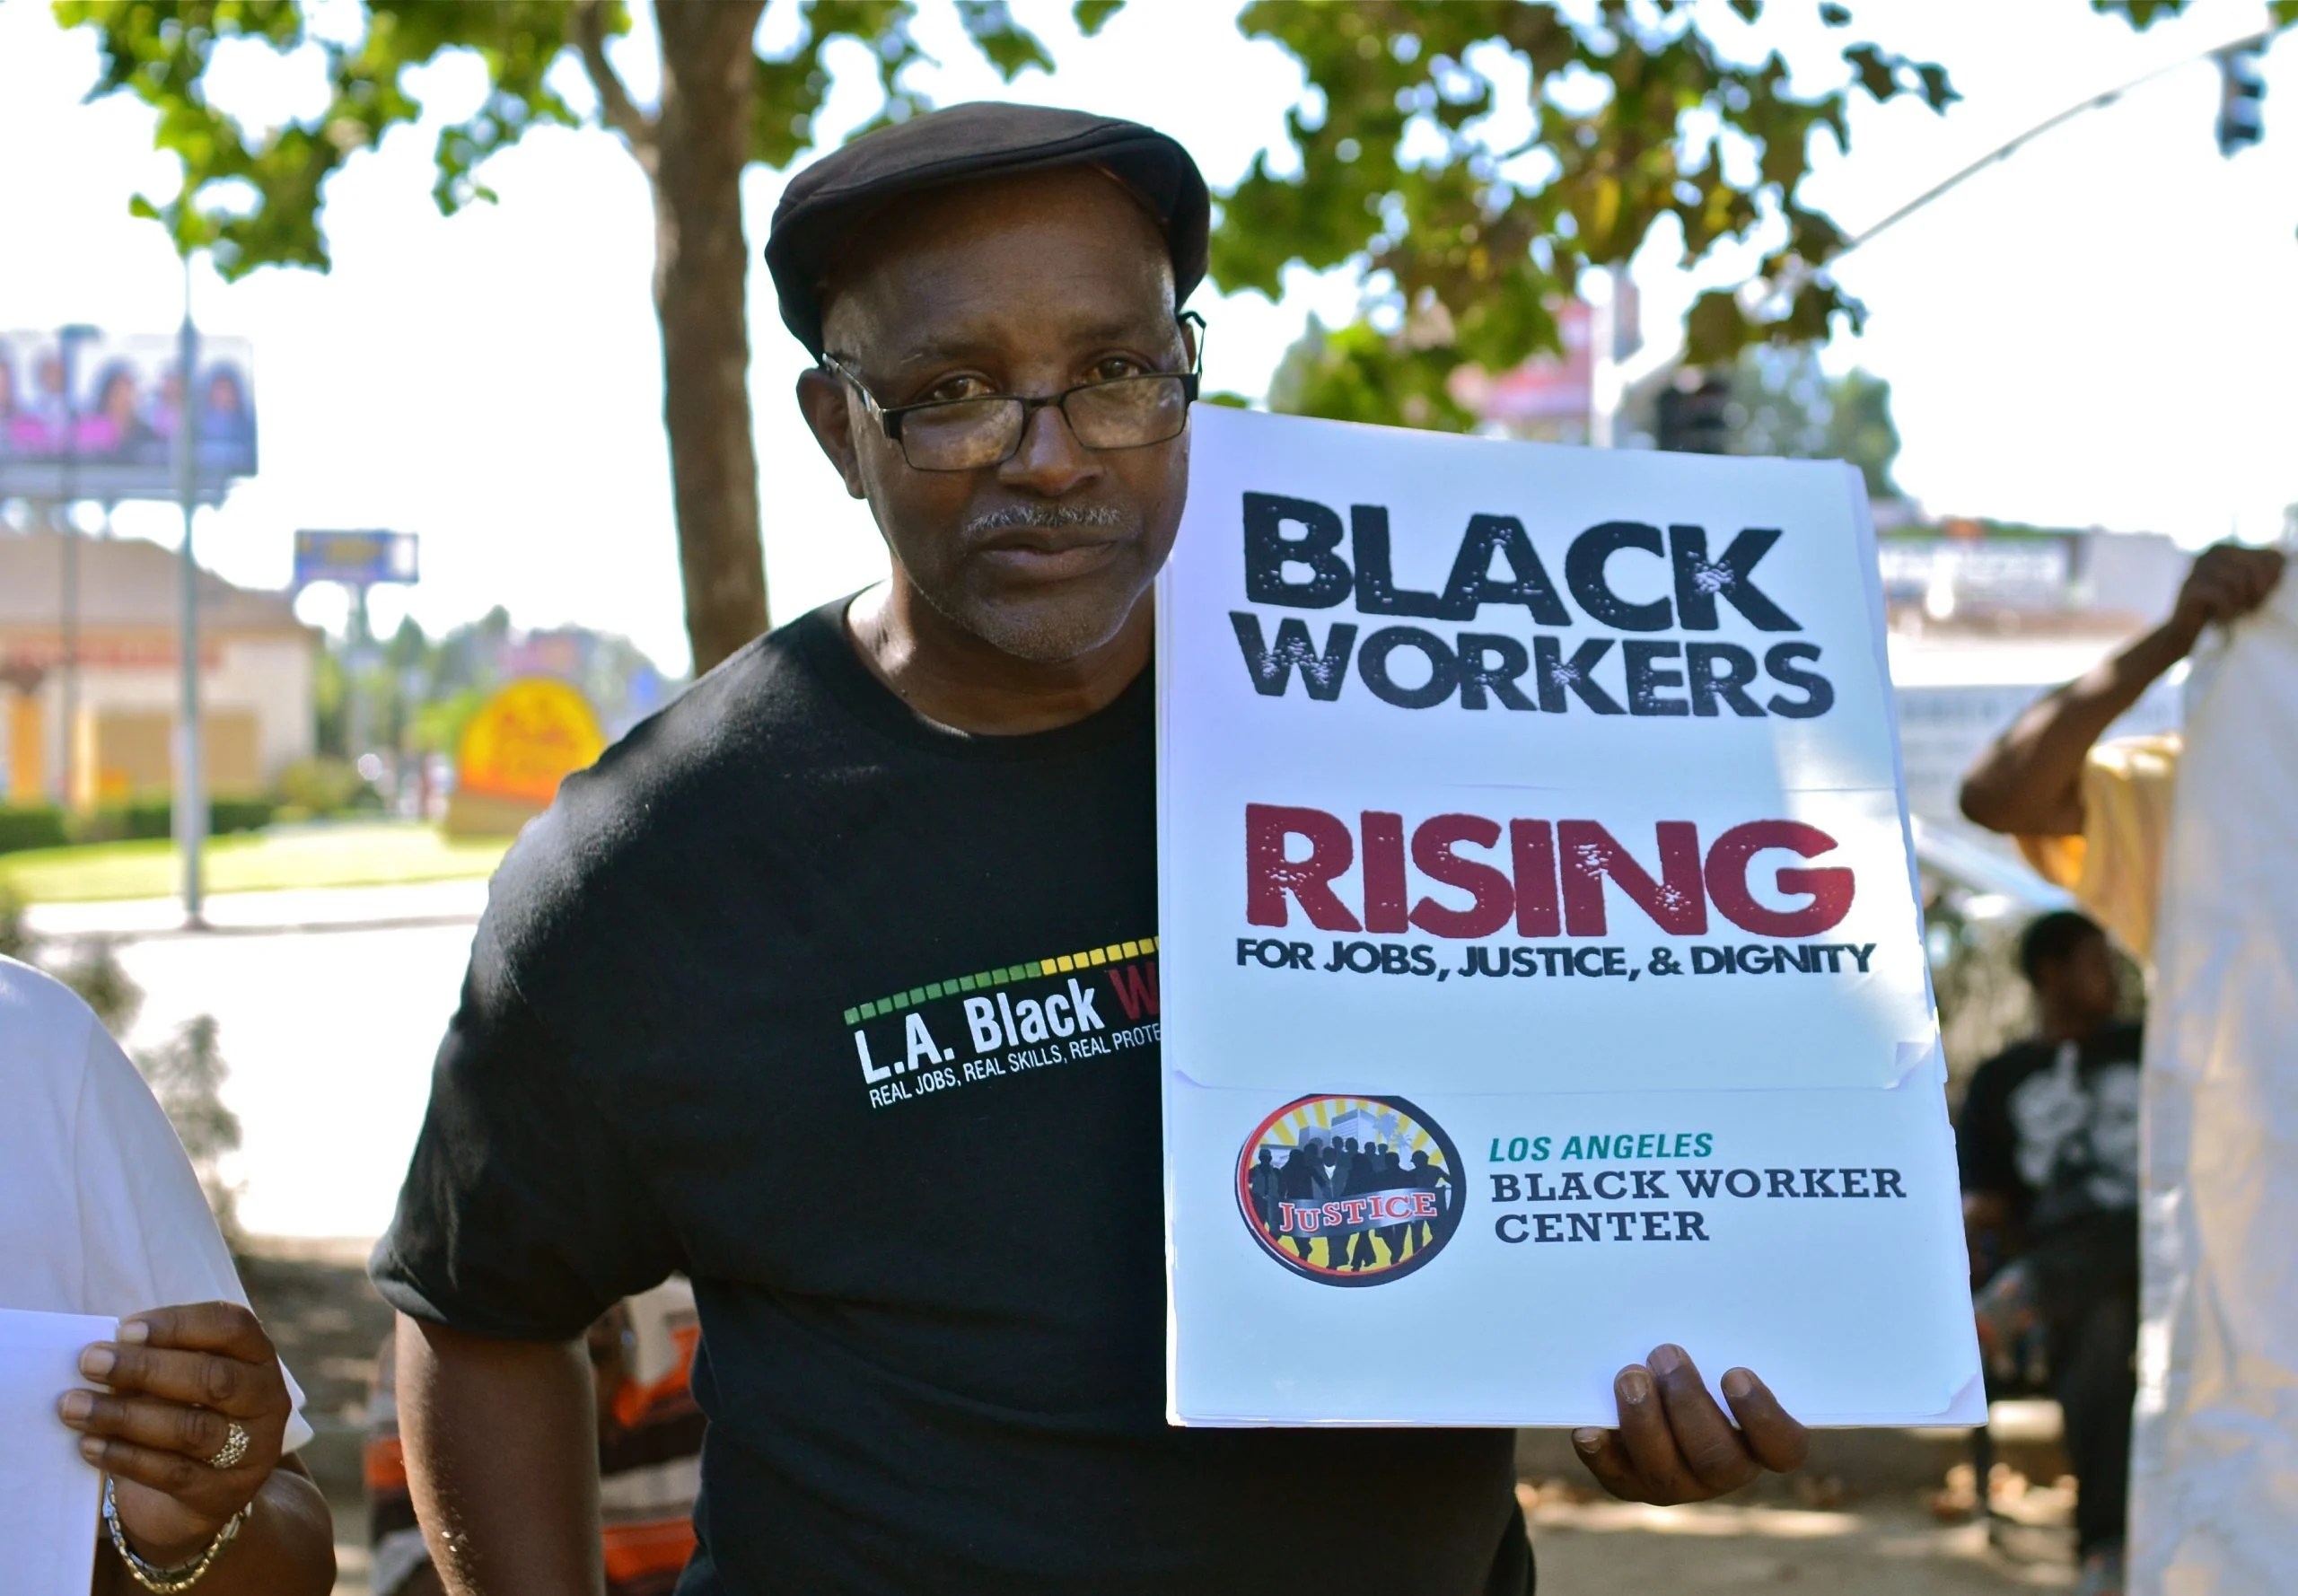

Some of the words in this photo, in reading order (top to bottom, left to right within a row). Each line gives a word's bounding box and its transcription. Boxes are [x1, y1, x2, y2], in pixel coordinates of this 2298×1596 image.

[1242, 490, 1802, 632] BLACK
[1229, 611, 1835, 719] WORKERS
[1245, 802, 1855, 939] RISING
[1236, 938, 1316, 971] FOR
[1323, 940, 1449, 982] JOBS,
[1458, 944, 1640, 982] JUSTICE,
[1648, 946, 1683, 976] &
[1691, 943, 1877, 975] DIGNITY
[855, 1013, 955, 1084] L.A.
[963, 978, 1105, 1054] Black
[869, 1080, 913, 1109] REAL
[915, 1066, 962, 1095] JOBS,
[962, 1057, 1006, 1083] REAL
[1007, 1044, 1068, 1073] SKILLS,
[1068, 1036, 1111, 1059] REAL
[1488, 1136, 1552, 1162] LOS
[1560, 1132, 1715, 1161] ANGELES
[1278, 1192, 1438, 1232] JUSTICE
[1489, 1171, 1670, 1203] BLACK
[1676, 1168, 1908, 1199] WORKER
[1494, 1210, 1711, 1245] CENTER
